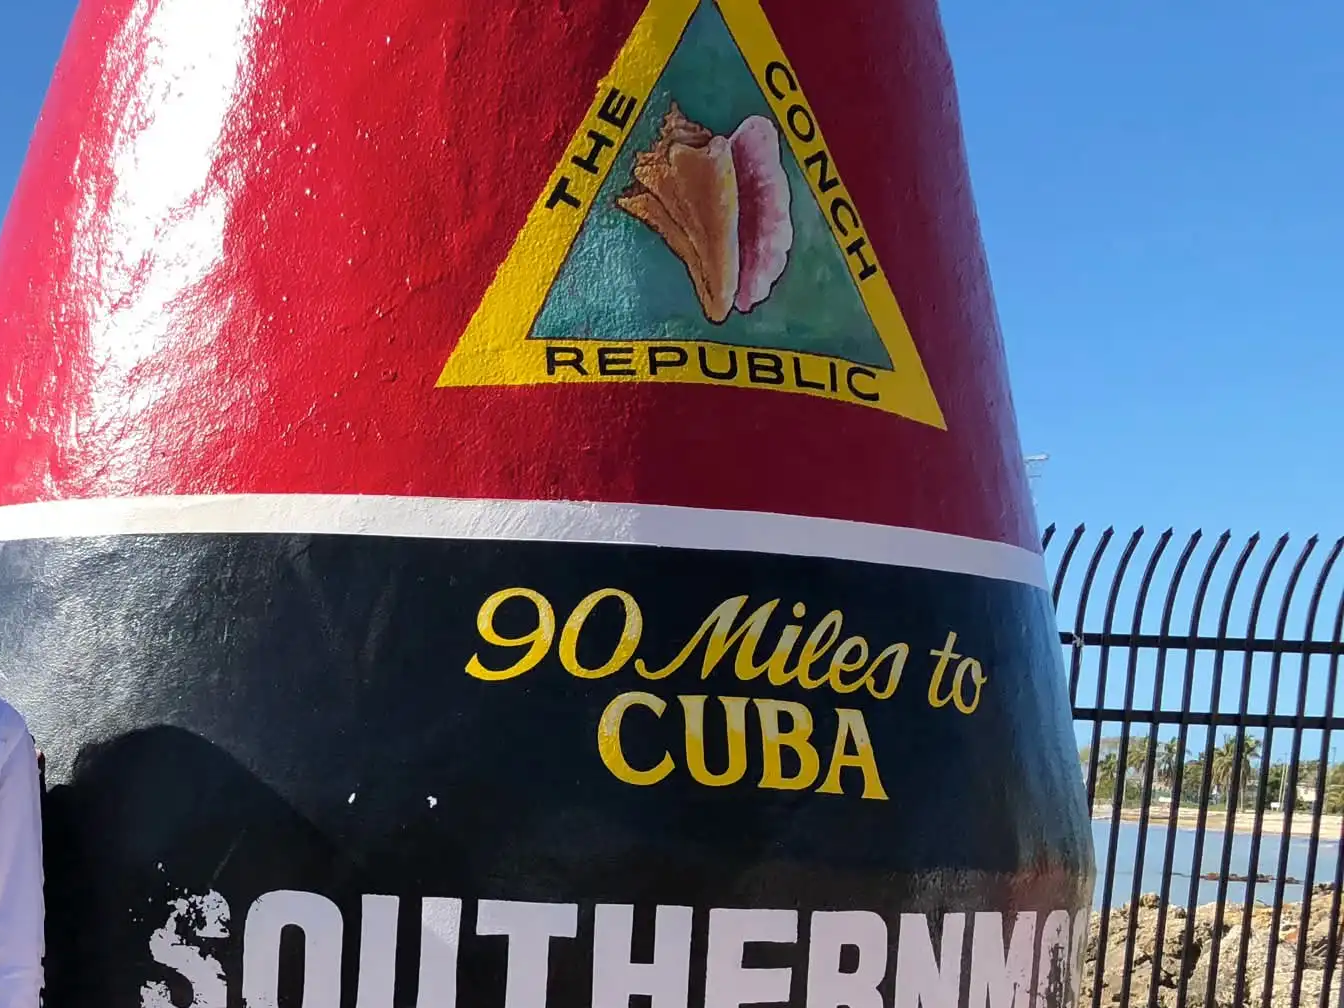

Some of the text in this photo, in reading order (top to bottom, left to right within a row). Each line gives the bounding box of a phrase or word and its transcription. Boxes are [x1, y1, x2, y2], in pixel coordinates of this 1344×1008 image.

[545, 89, 637, 212] THE
[765, 60, 877, 281] CONCH
[546, 346, 880, 402] REPUBLIC
[465, 587, 987, 714] 90 Miles to
[597, 691, 890, 800] CUBA
